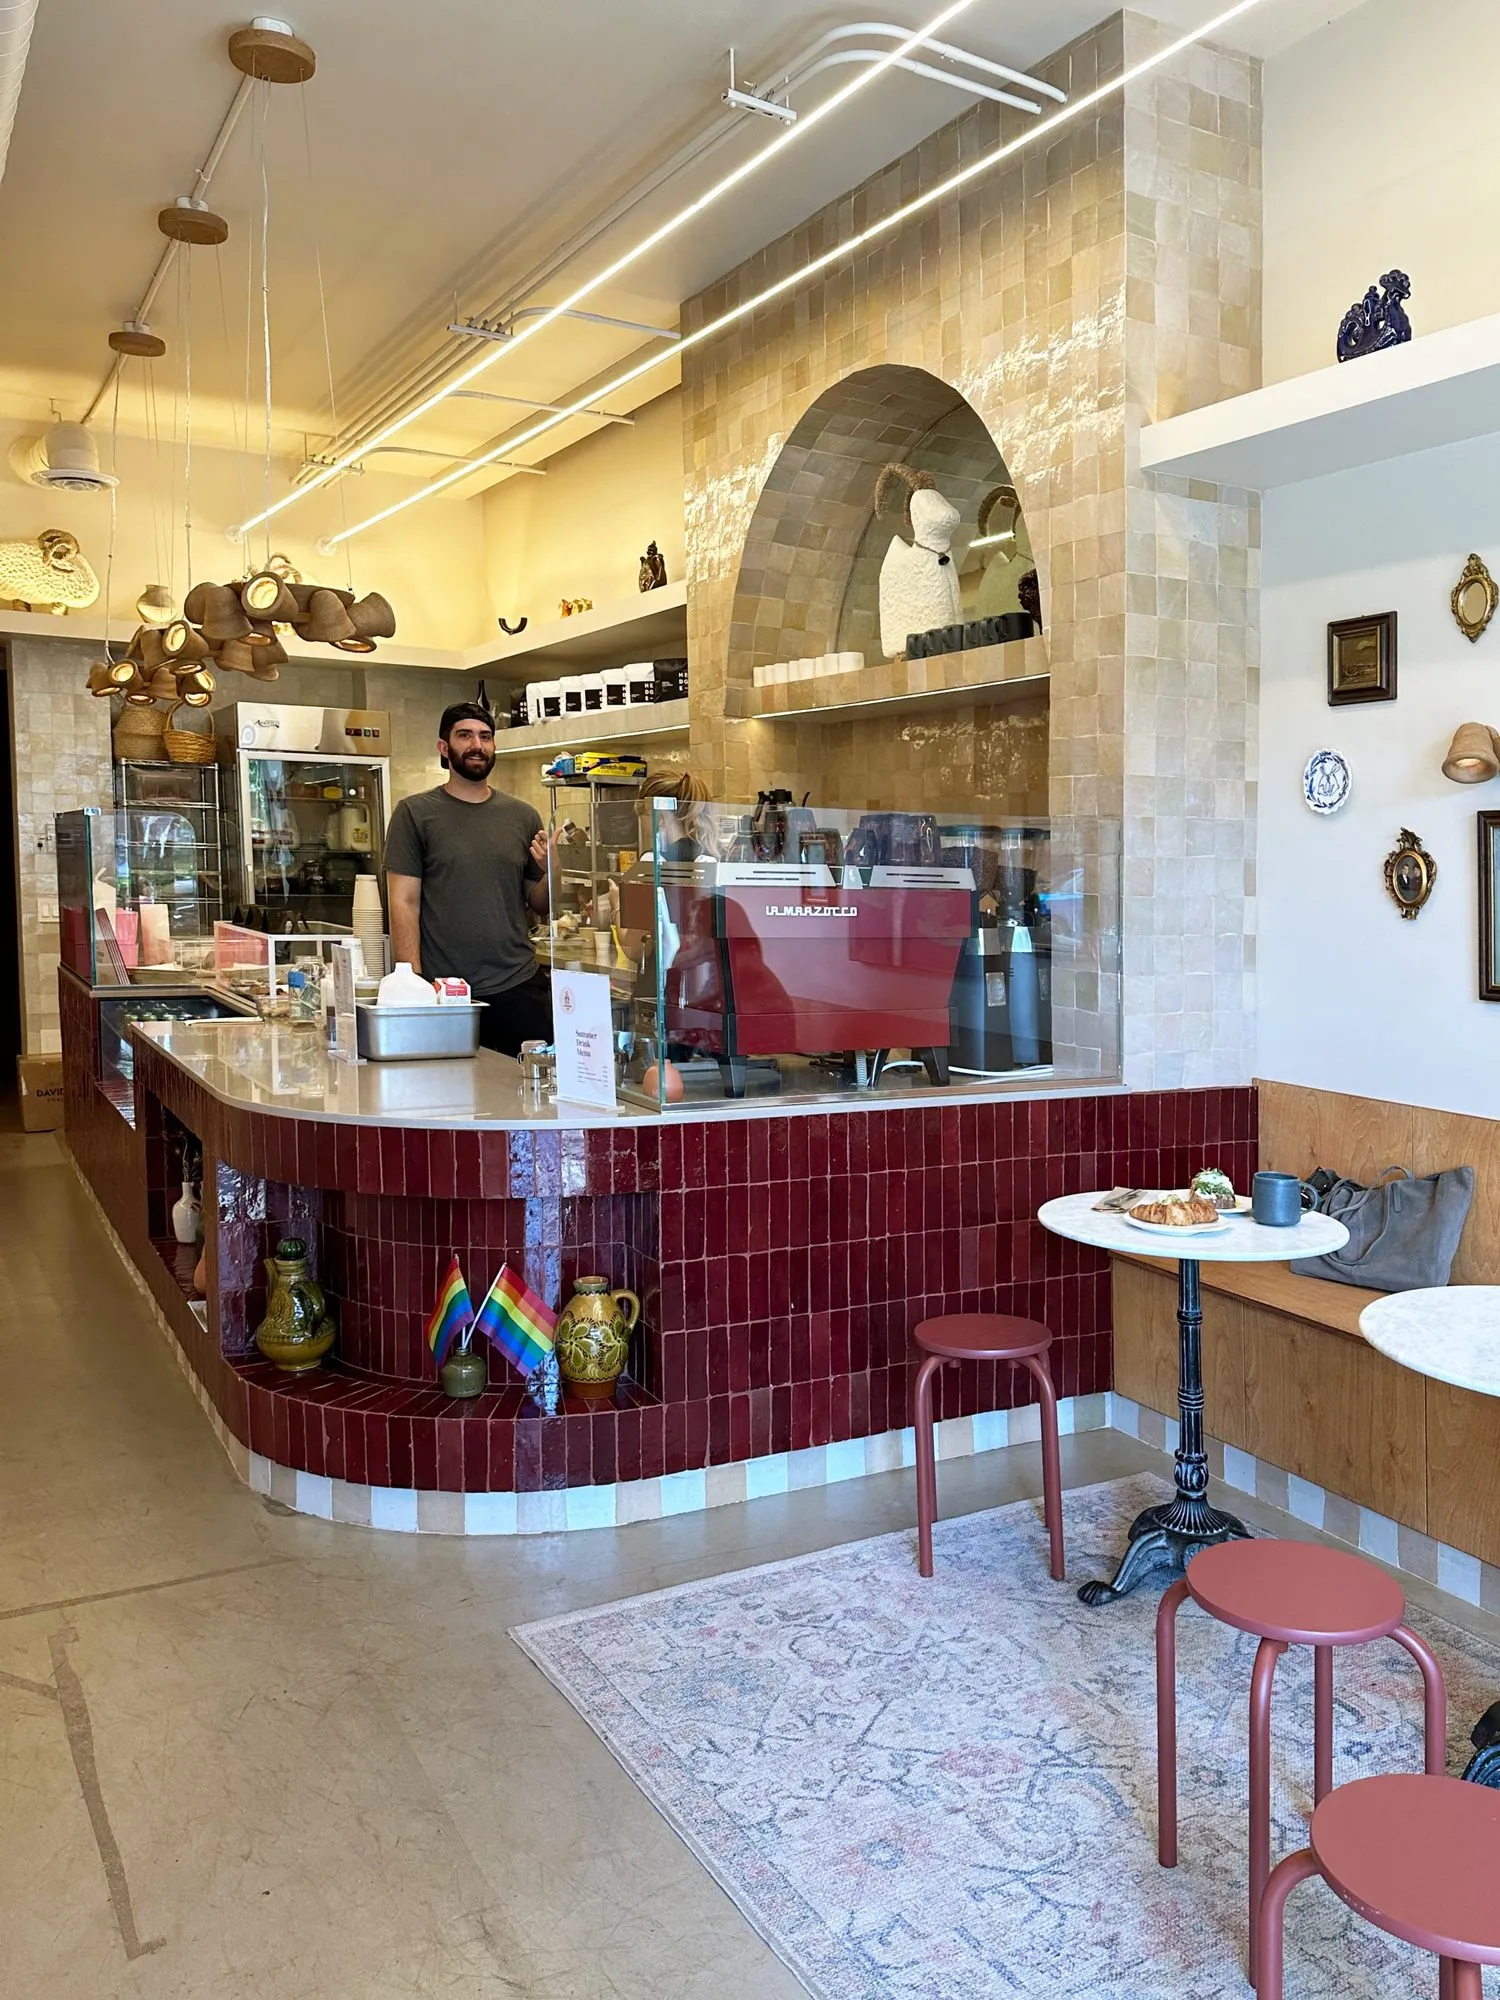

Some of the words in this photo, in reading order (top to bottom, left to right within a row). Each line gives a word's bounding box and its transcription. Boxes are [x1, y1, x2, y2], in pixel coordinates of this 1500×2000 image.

[575, 1030, 597, 1040] Summer
[576, 1039, 590, 1048] Drink
[577, 1048, 591, 1058] Menu
